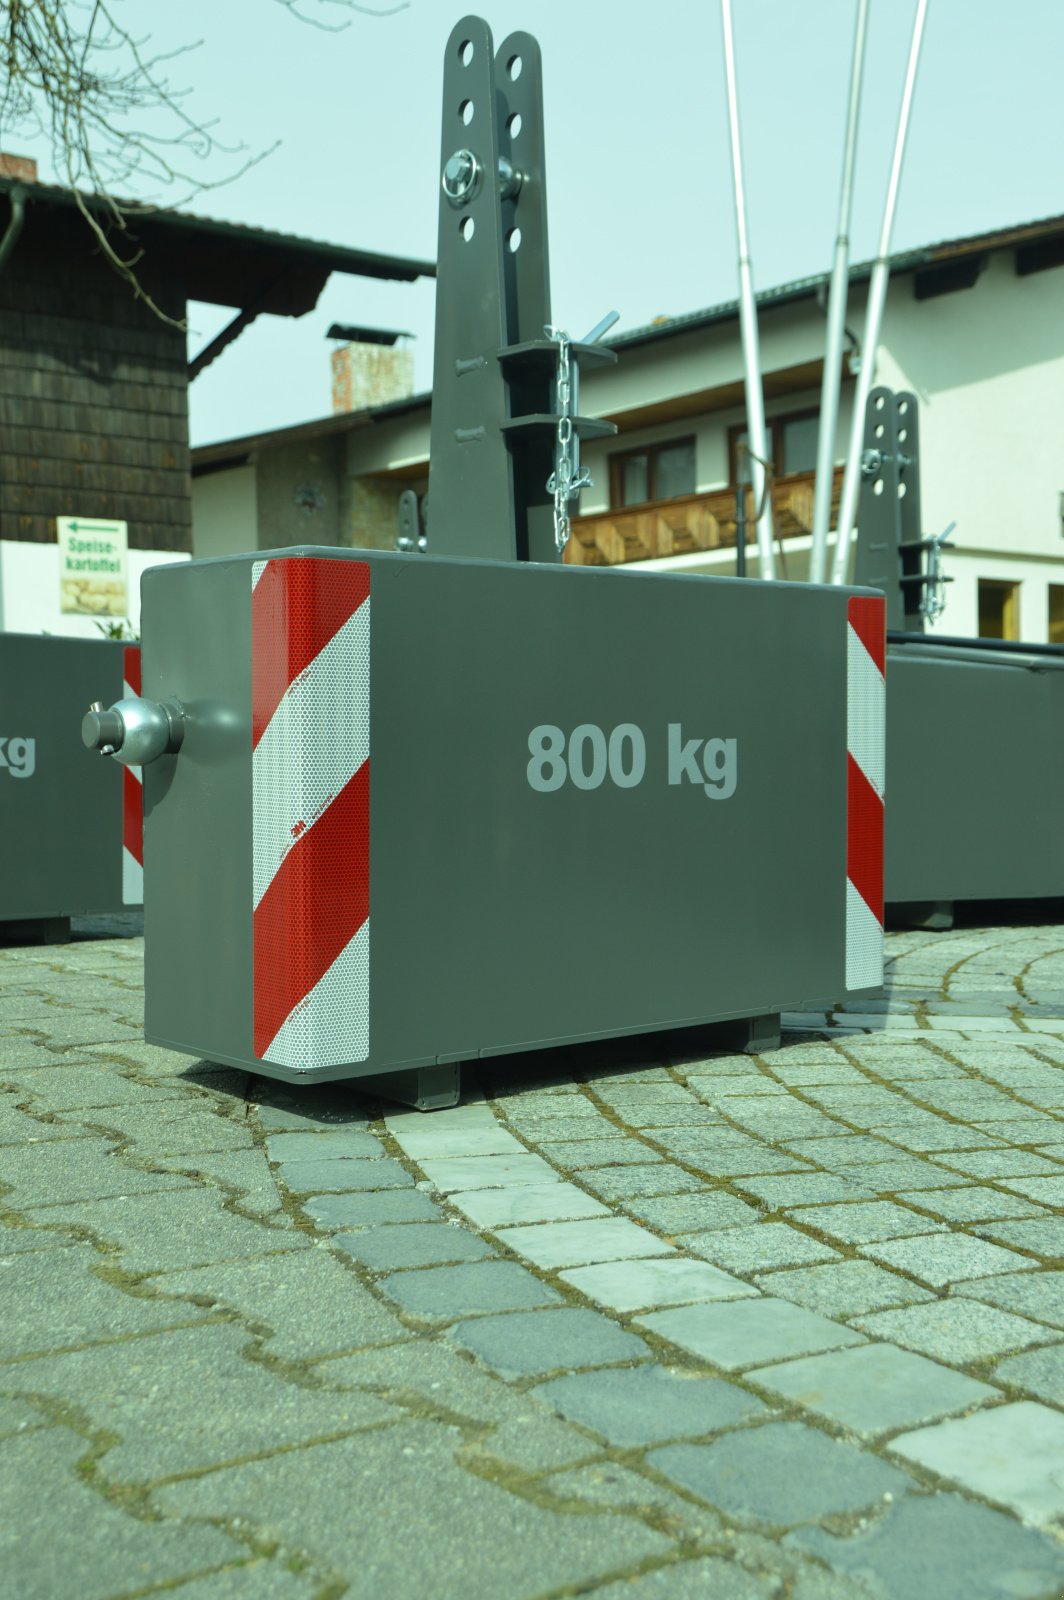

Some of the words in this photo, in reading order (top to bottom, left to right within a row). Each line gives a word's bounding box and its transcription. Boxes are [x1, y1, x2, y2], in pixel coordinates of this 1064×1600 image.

[68, 537, 117, 553] Speise-
[66, 556, 121, 572] kartoffel
[526, 722, 647, 793] 800
[667, 722, 738, 800] kg
